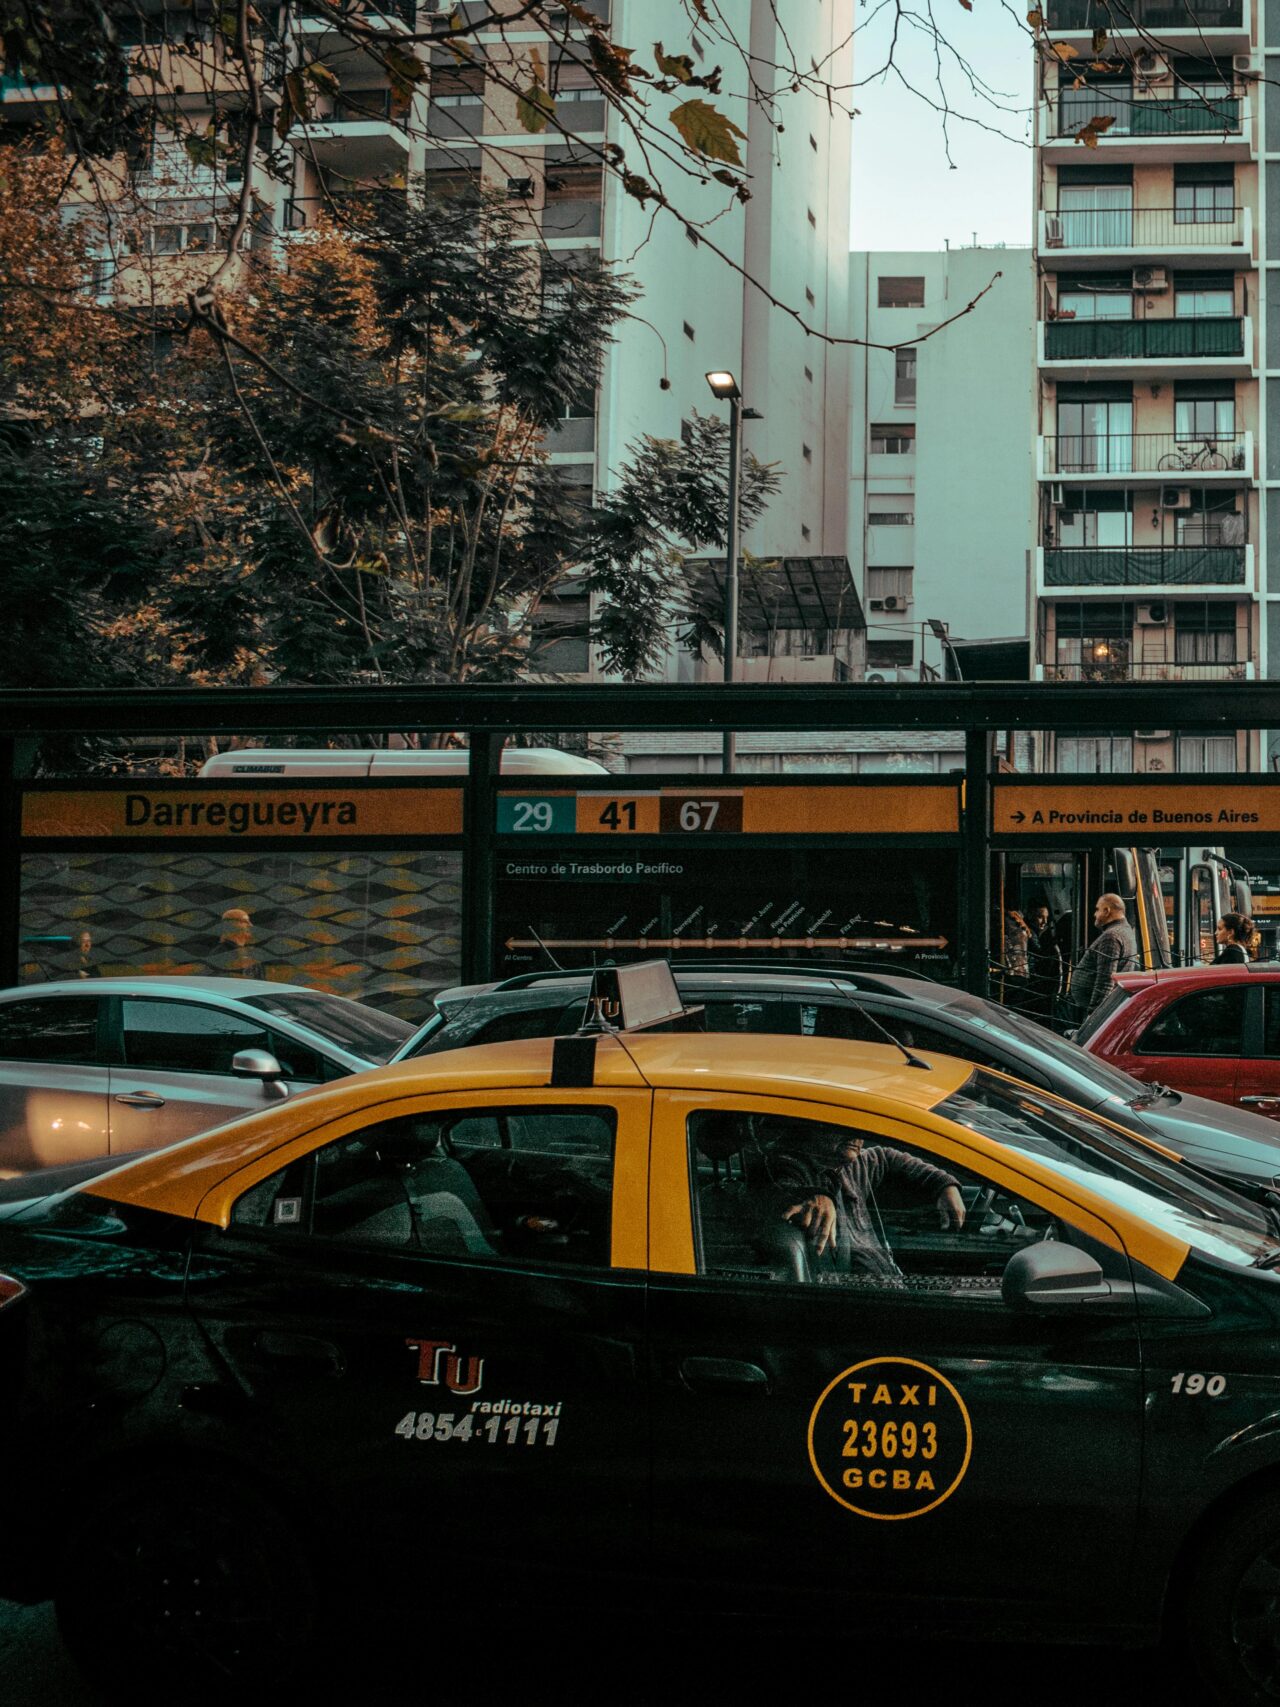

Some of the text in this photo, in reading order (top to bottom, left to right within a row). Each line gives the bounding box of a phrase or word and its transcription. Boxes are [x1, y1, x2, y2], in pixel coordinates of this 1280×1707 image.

[125, 794, 357, 833] Darregueyra
[513, 801, 720, 831] 29 41 67
[1032, 809, 1259, 824] A Provincia de Buenos Aires
[506, 862, 683, 875] Centro de Trasbordo Pacífico
[673, 904, 704, 935] Darregueyra
[706, 924, 718, 934] Oro
[405, 1338, 484, 1395] TU
[848, 1383, 937, 1406] TAXI
[1171, 1372, 1226, 1397] 190
[471, 1400, 562, 1416] radiotaxi
[842, 1419, 938, 1459] 23693
[842, 1468, 936, 1490] GCBA
